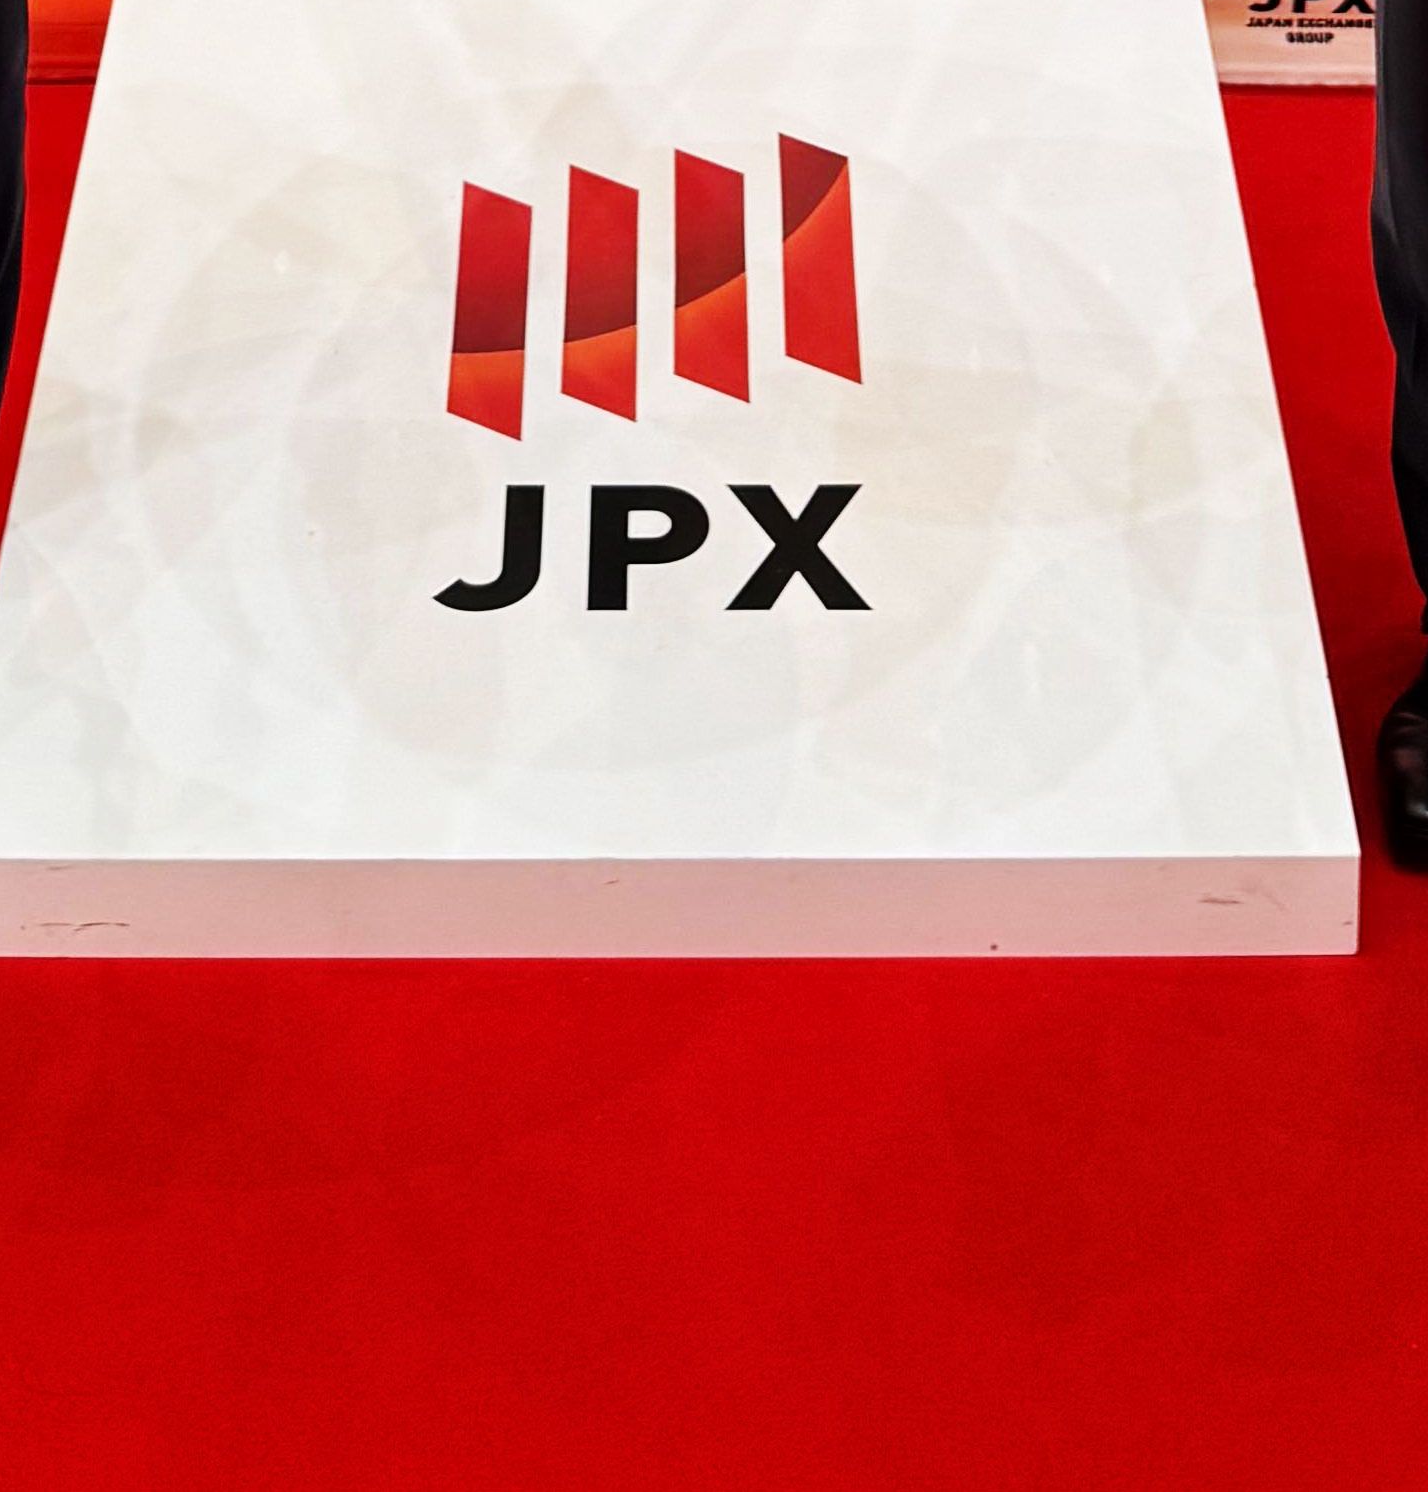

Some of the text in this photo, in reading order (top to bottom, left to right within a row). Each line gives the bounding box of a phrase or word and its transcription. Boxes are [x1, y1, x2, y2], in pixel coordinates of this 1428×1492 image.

[1246, 17, 1293, 28] JAPAN
[1285, 31, 1335, 43] GROUP
[433, 484, 872, 612] JPX
